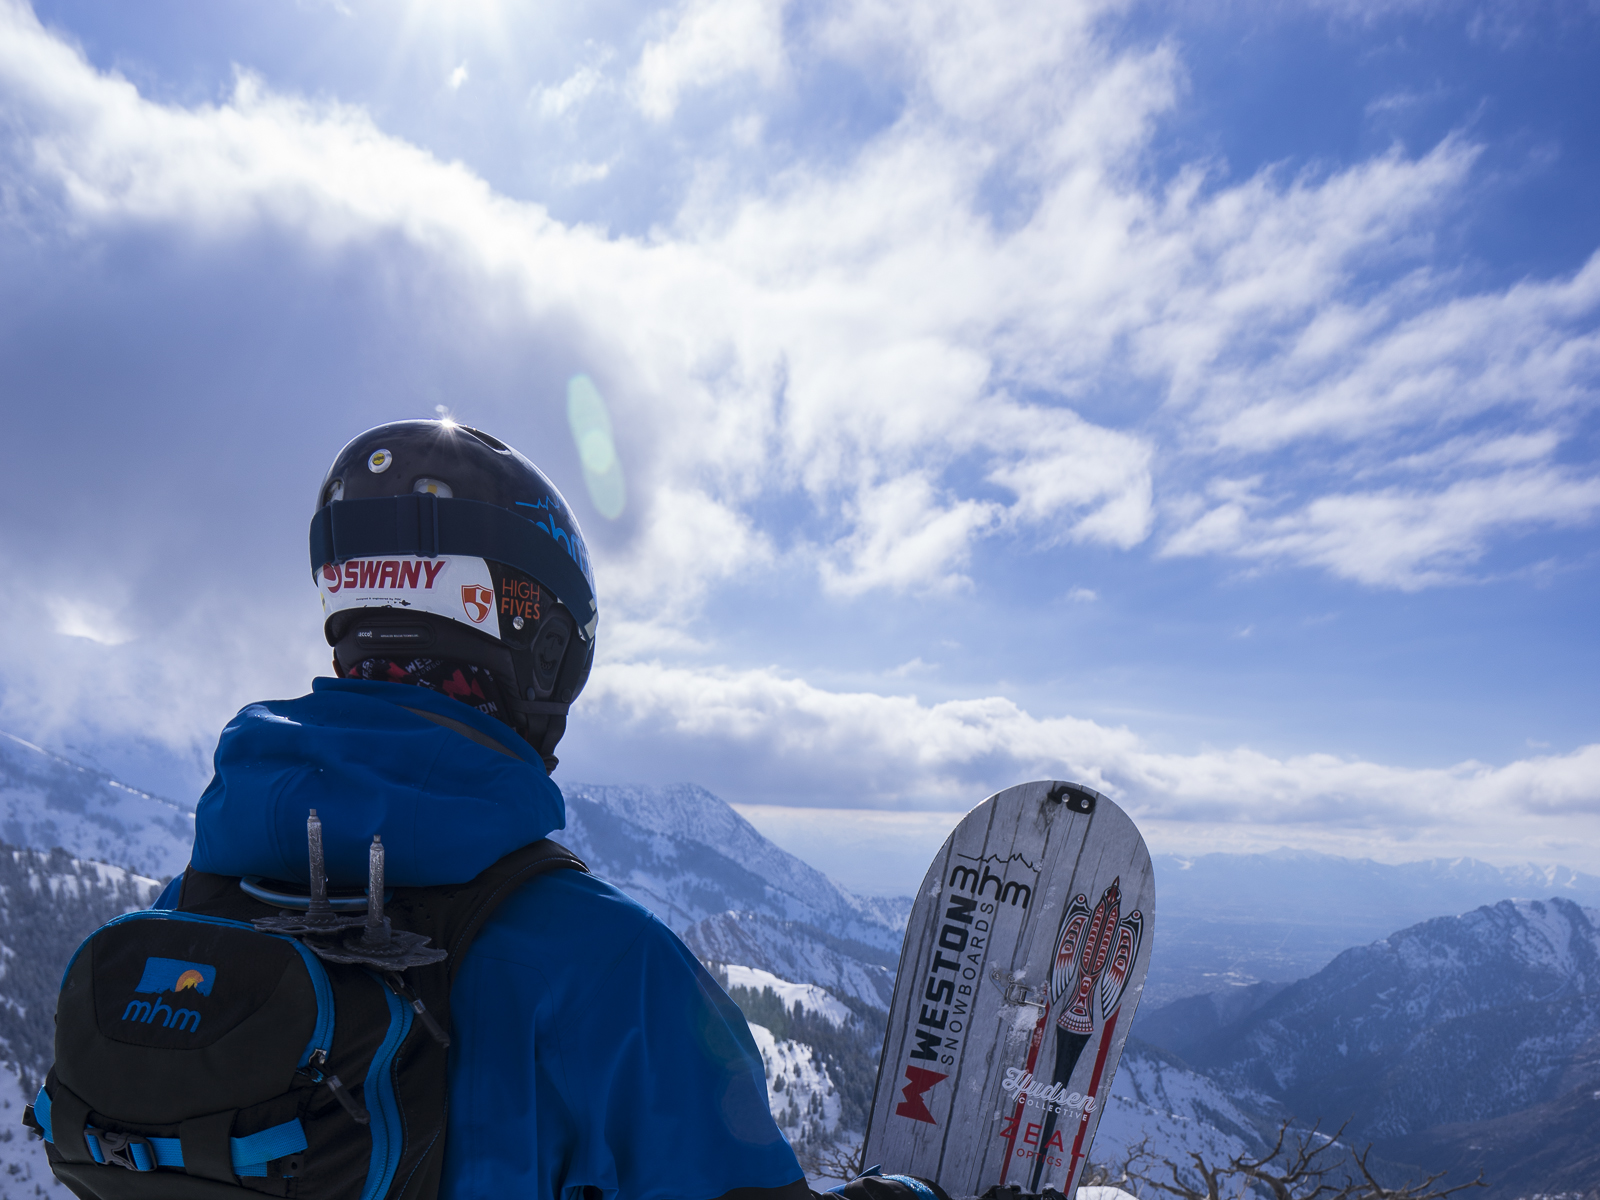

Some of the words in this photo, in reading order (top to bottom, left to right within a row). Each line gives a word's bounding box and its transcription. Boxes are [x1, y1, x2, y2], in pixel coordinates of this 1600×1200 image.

[344, 561, 446, 589] SWANY
[502, 578, 540, 601] HIGH
[501, 597, 540, 620] FIVES
[949, 865, 1031, 909] mhm
[910, 894, 978, 1061] WESTON
[941, 902, 994, 1066] SNOWBOARDS
[121, 996, 202, 1033] mhm
[1002, 1067, 1098, 1113] Hudsen
[1018, 1097, 1088, 1122] COLLECTIVE
[1000, 1116, 1085, 1158] ZEAL
[1016, 1148, 1062, 1167] OPTICS
